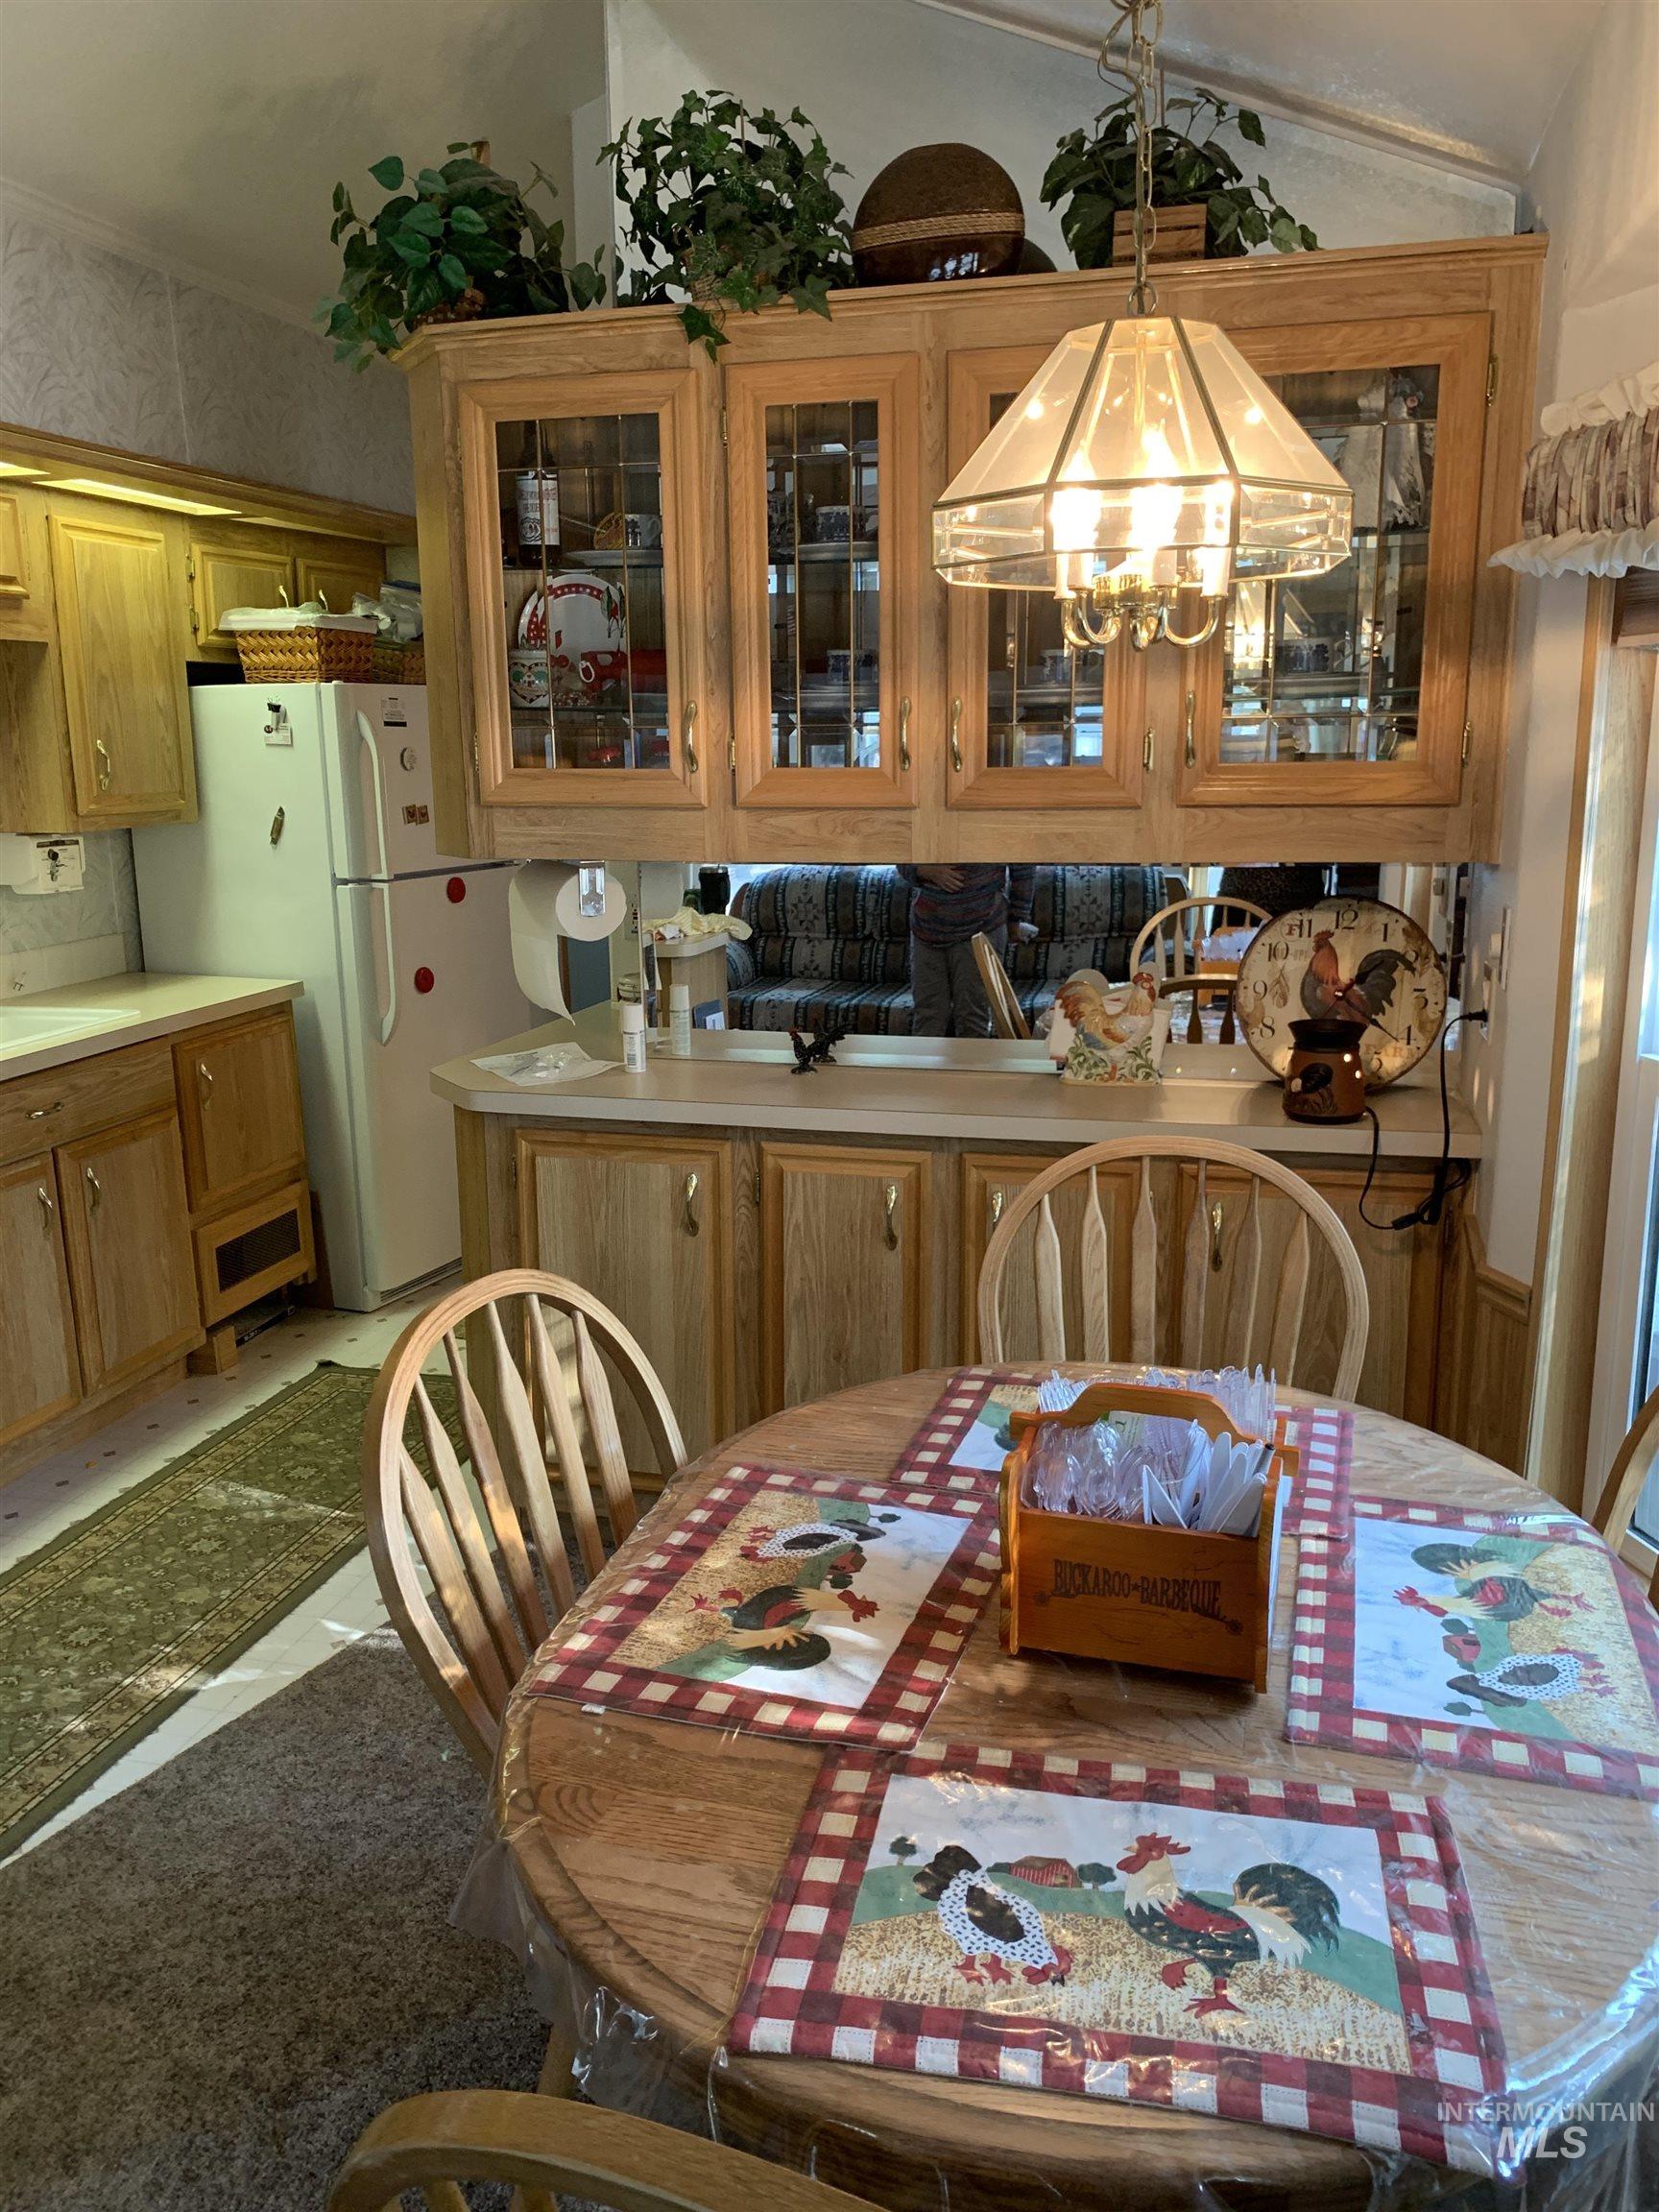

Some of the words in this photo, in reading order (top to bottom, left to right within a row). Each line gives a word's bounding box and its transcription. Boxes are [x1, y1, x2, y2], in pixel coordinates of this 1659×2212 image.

[1298, 918, 1313, 939] 11
[1334, 908, 1358, 930] 12
[1382, 923, 1388, 943] 1
[1267, 941, 1290, 963] 10
[1252, 980, 1268, 999] 9
[1260, 1016, 1276, 1040] 8
[1052, 1558, 1131, 1599] BUCKAROO
[1139, 1575, 1222, 1620] BARBEQUE
